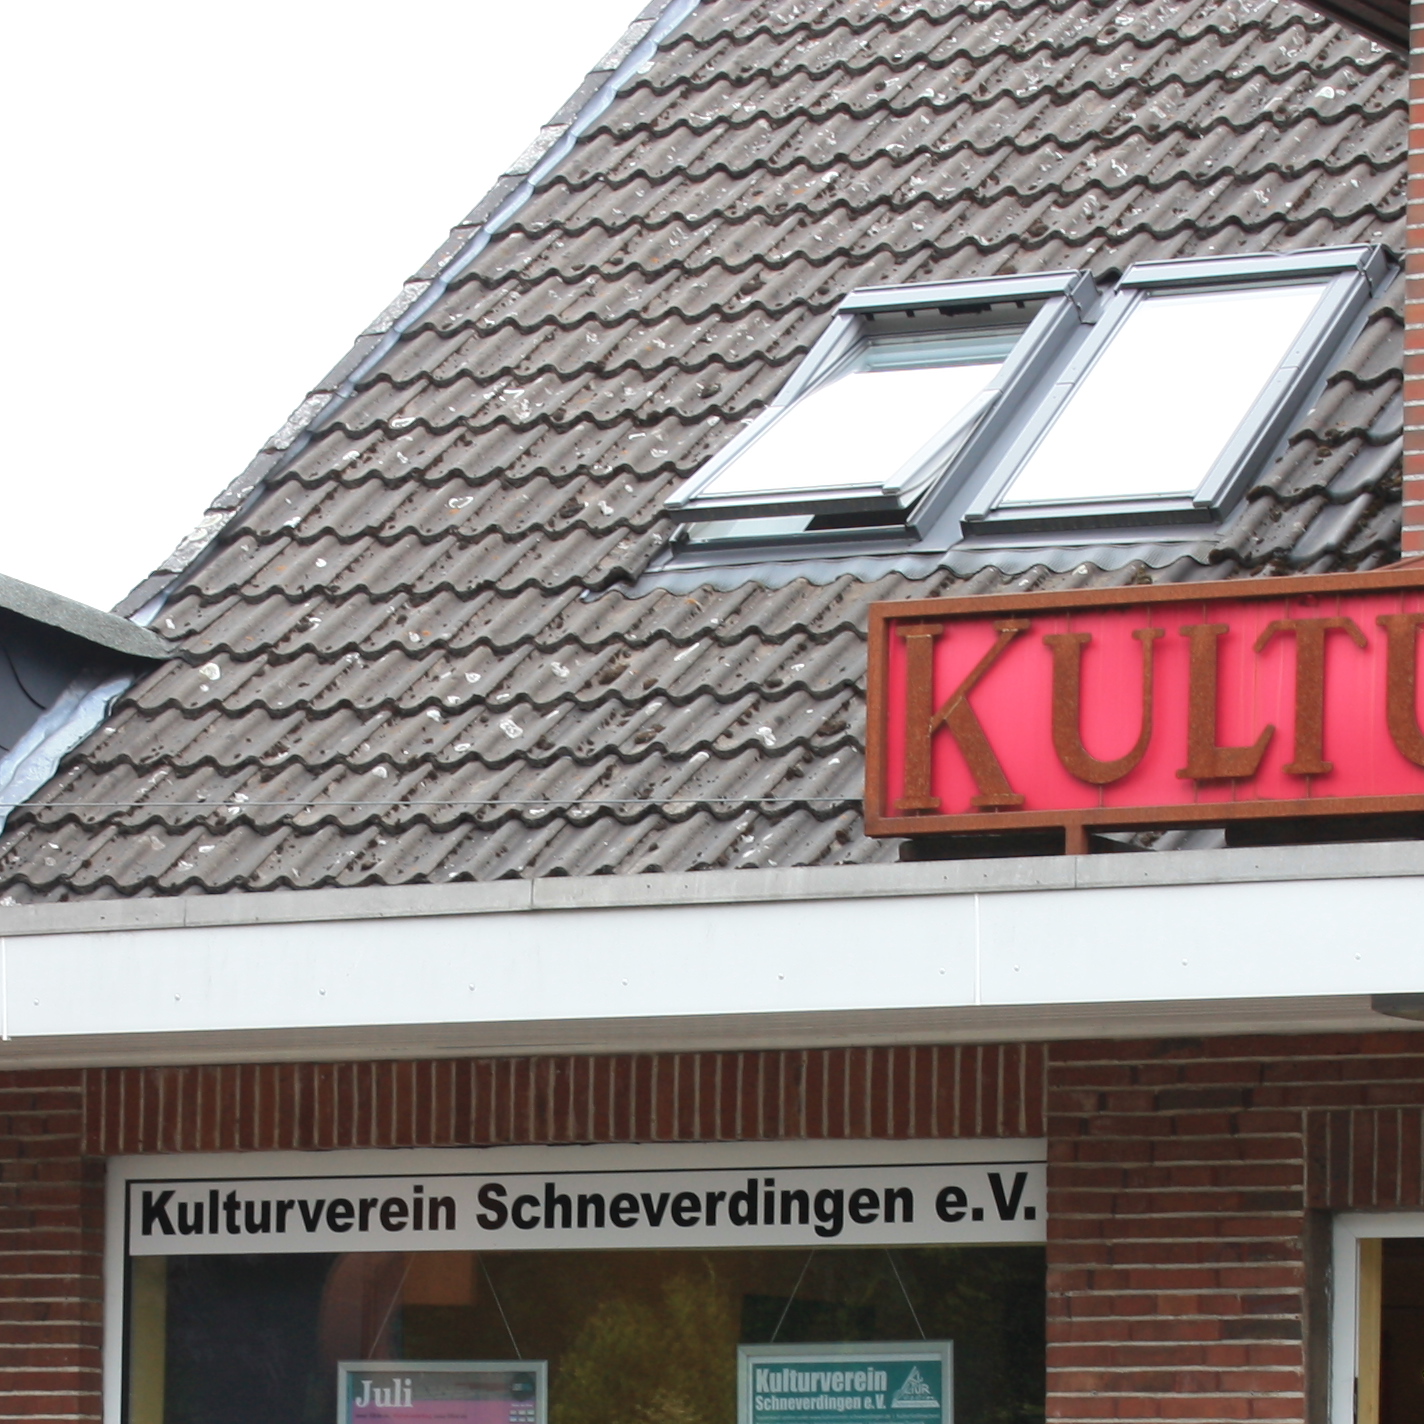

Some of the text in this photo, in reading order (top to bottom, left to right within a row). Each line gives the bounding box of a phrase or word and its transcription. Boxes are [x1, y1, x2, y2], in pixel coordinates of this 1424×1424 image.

[141, 1171, 1038, 1239] Kulturverein Schneverdingen e.V.
[355, 1378, 414, 1409] Juli
[756, 1368, 888, 1393] Kulturverein
[756, 1394, 861, 1413] Schneverdingen
